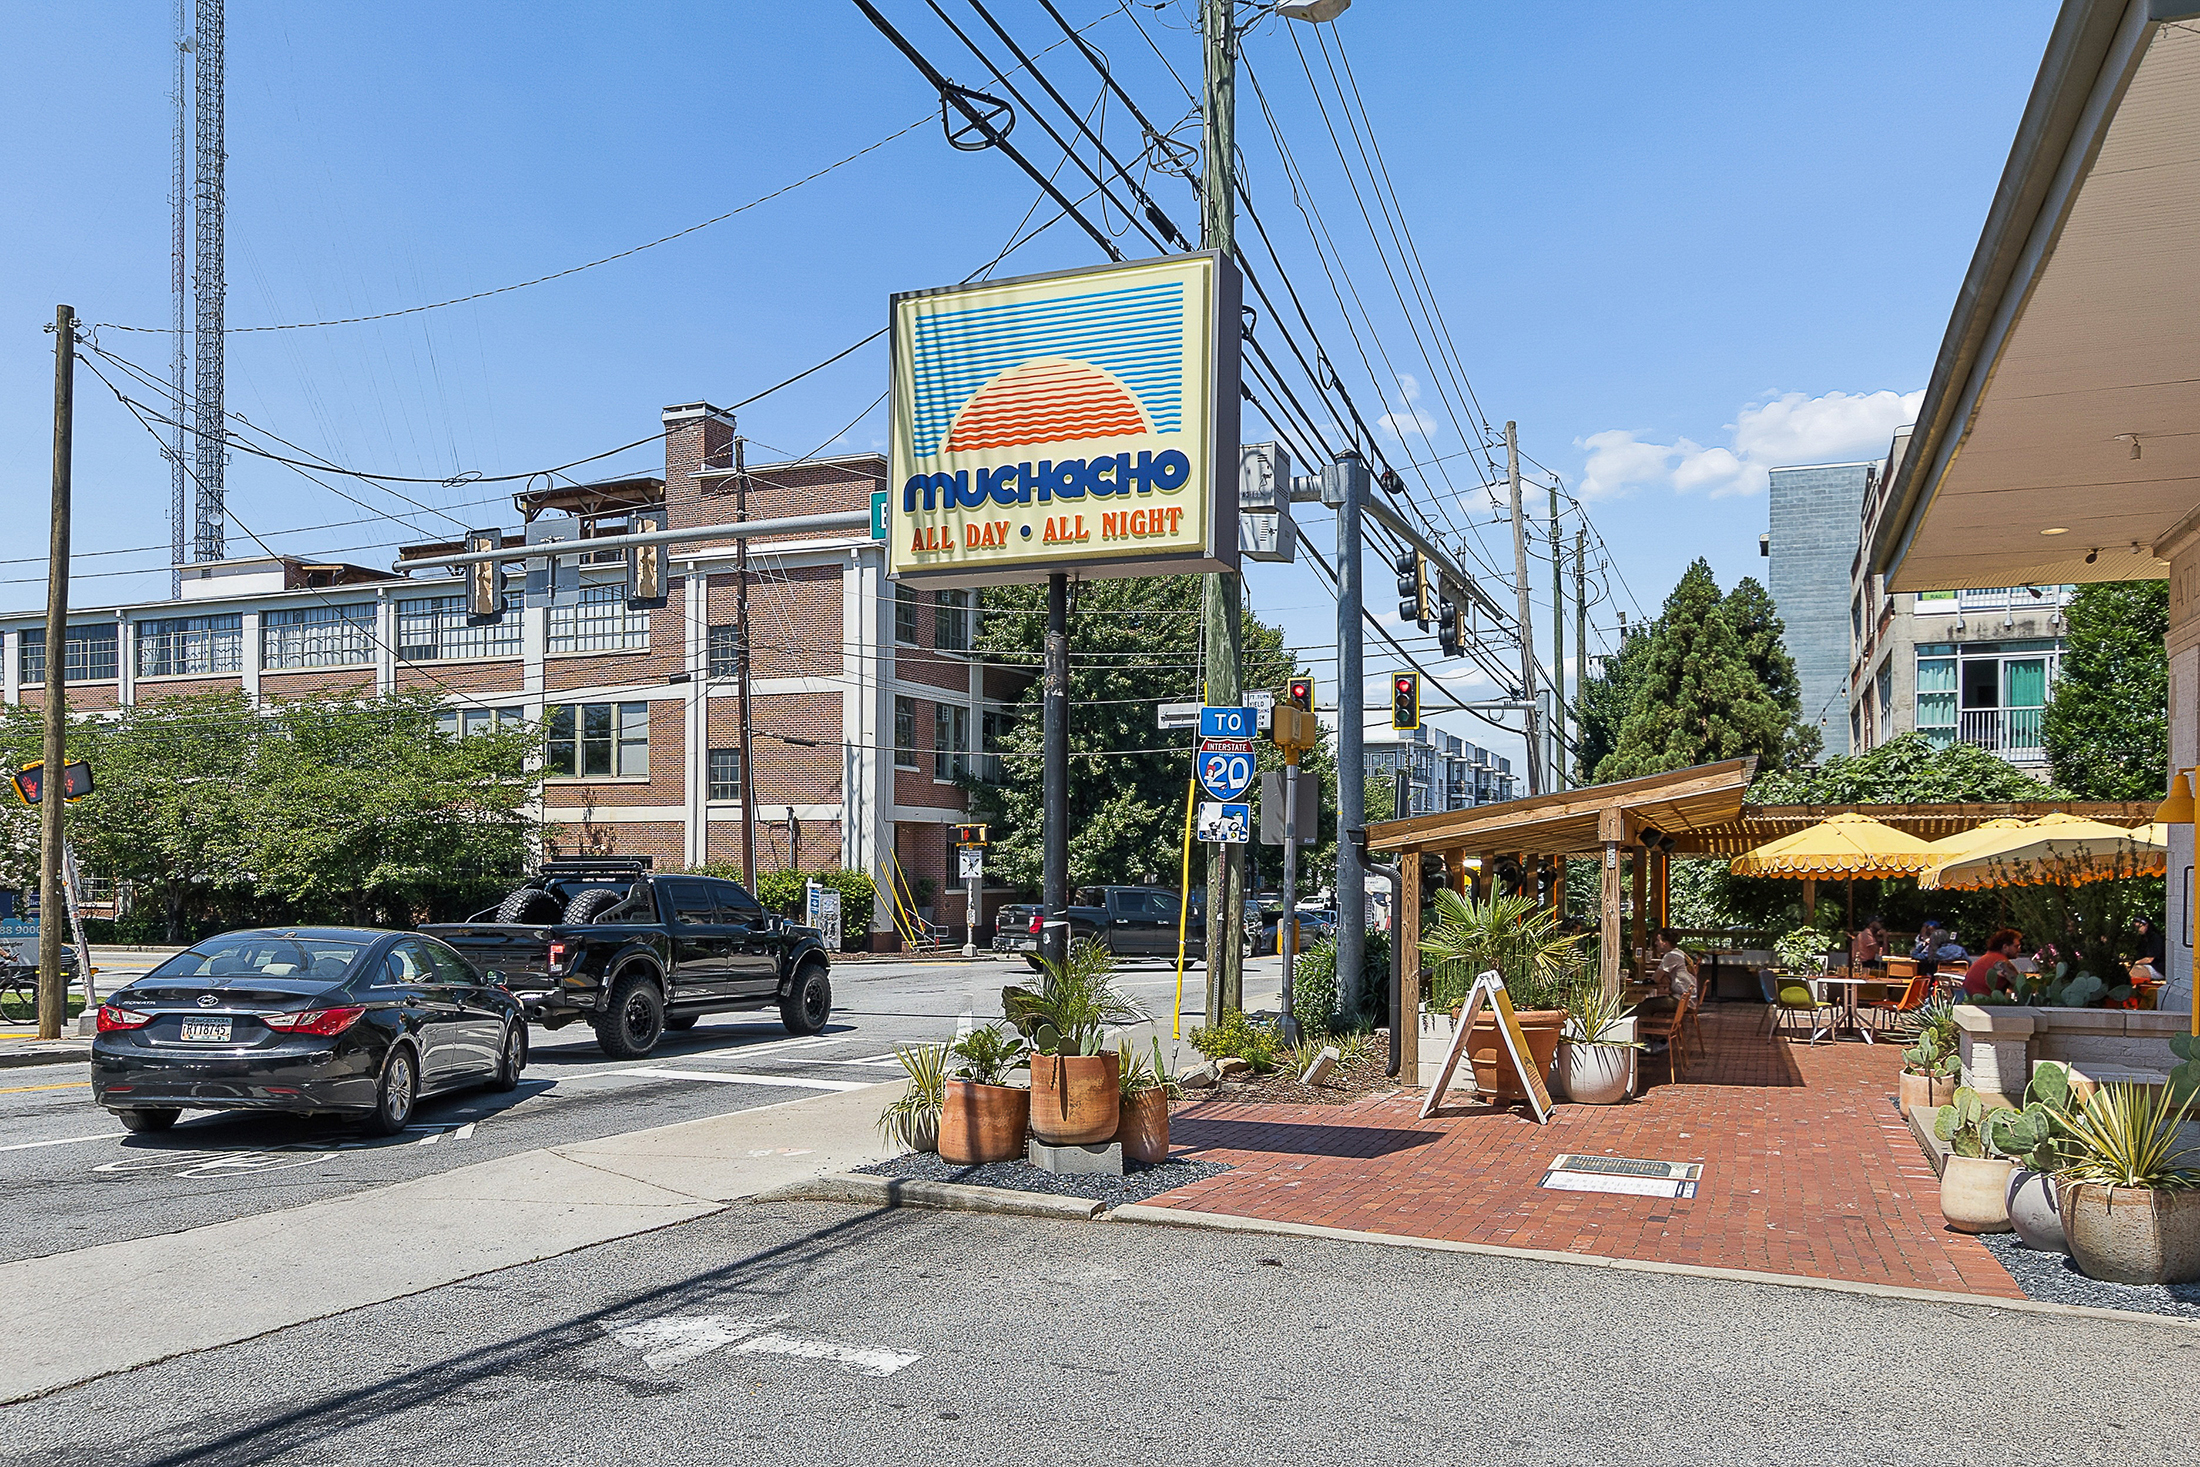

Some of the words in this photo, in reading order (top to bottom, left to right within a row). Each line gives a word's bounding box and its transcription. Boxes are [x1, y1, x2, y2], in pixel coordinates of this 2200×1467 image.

[911, 525, 954, 552] ALL
[966, 520, 1011, 548] DAY
[1043, 515, 1089, 543] ALL
[1102, 506, 1183, 537] NIGHT
[1214, 713, 1242, 731] TO
[1207, 743, 1247, 751] INTERSTATE
[1204, 756, 1249, 788] 20
[187, 1024, 226, 1035] RYT8745
